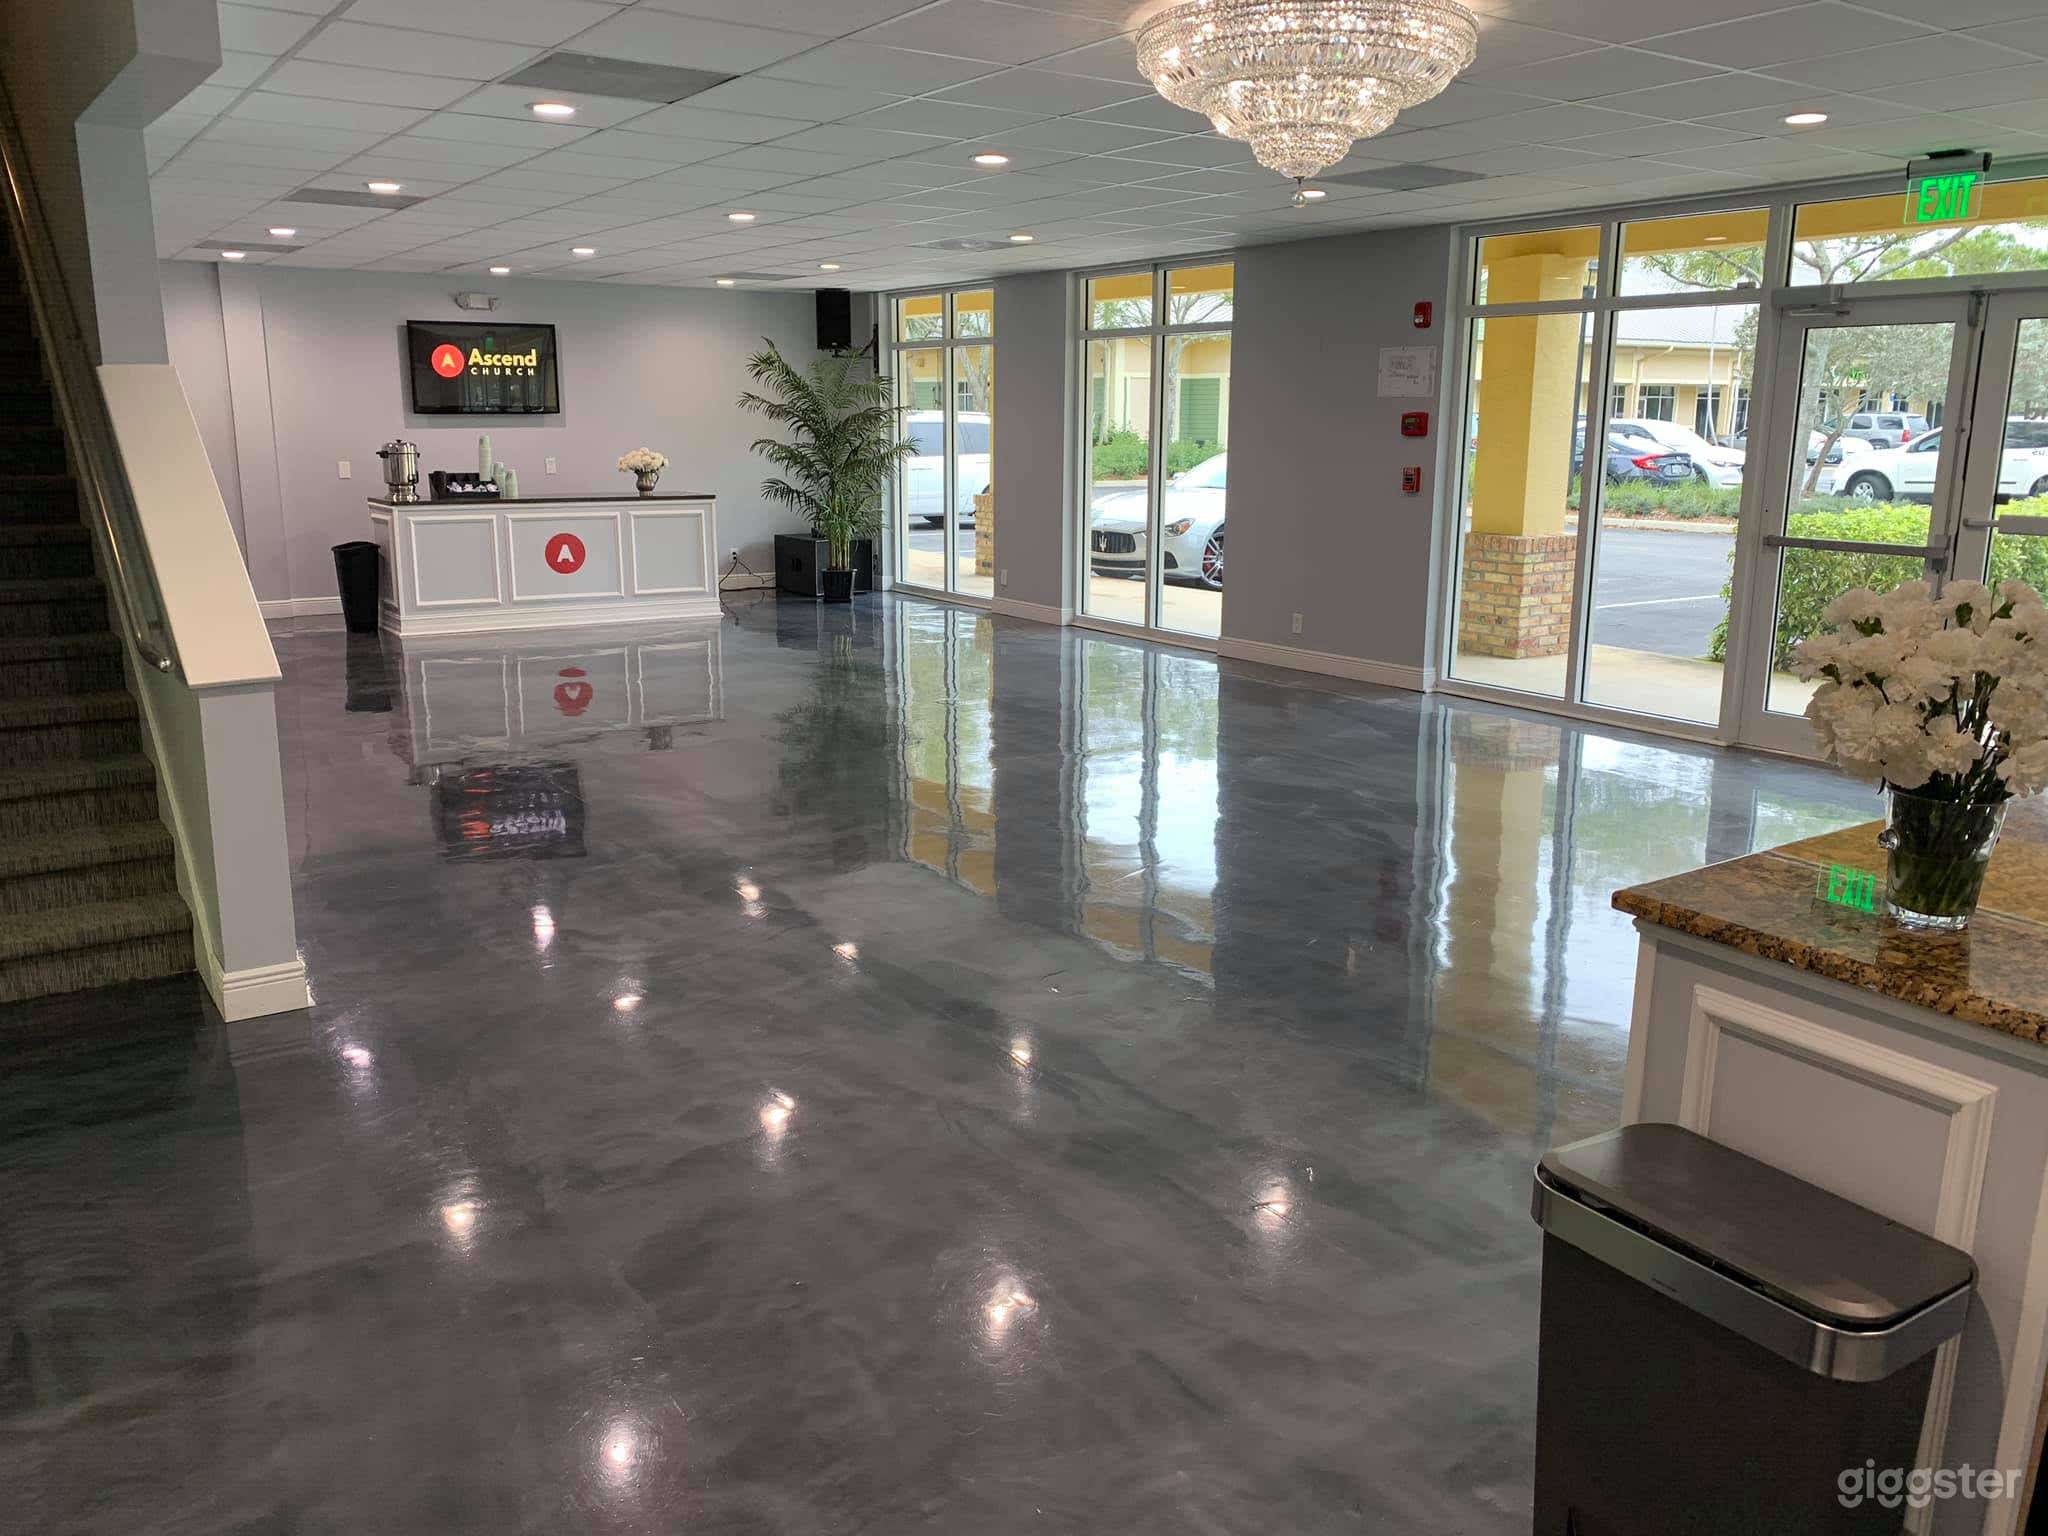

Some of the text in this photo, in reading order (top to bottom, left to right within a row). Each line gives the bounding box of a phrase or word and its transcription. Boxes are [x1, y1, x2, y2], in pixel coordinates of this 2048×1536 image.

[1917, 173, 1976, 222] EXIT
[441, 352, 456, 368] A
[468, 347, 537, 367] Ascend
[470, 367, 535, 376] CHURCH
[556, 543, 576, 563] A
